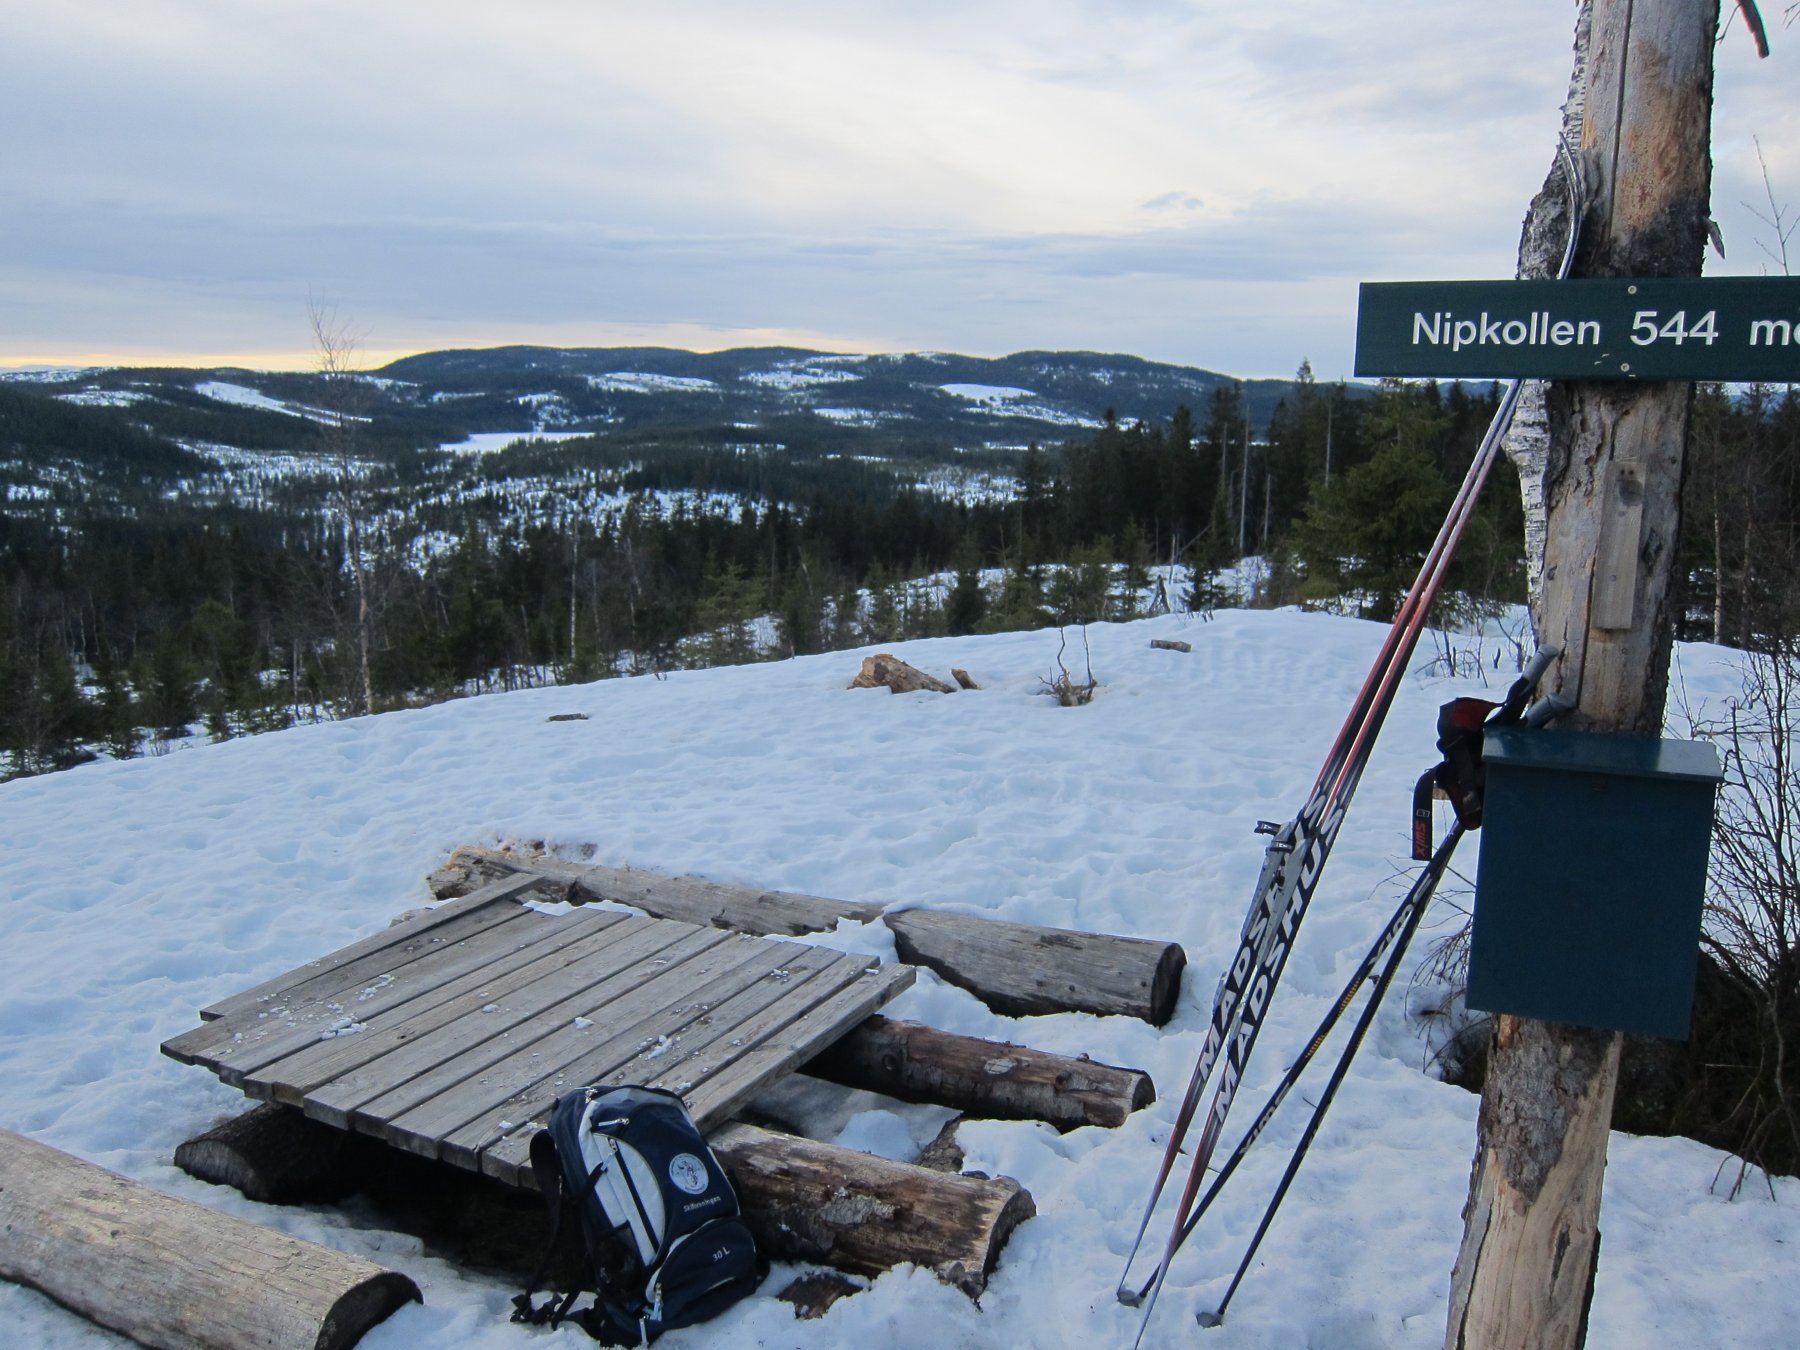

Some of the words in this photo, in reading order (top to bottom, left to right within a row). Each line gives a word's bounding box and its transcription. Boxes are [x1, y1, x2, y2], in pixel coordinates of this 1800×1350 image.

[1412, 311, 1600, 352] Nipkollen
[1629, 310, 1719, 346] 544
[1749, 318, 1800, 346] m
[1216, 798, 1343, 1123] MADSHUS
[712, 1250, 723, 1262] 30
[722, 1246, 731, 1255] L
